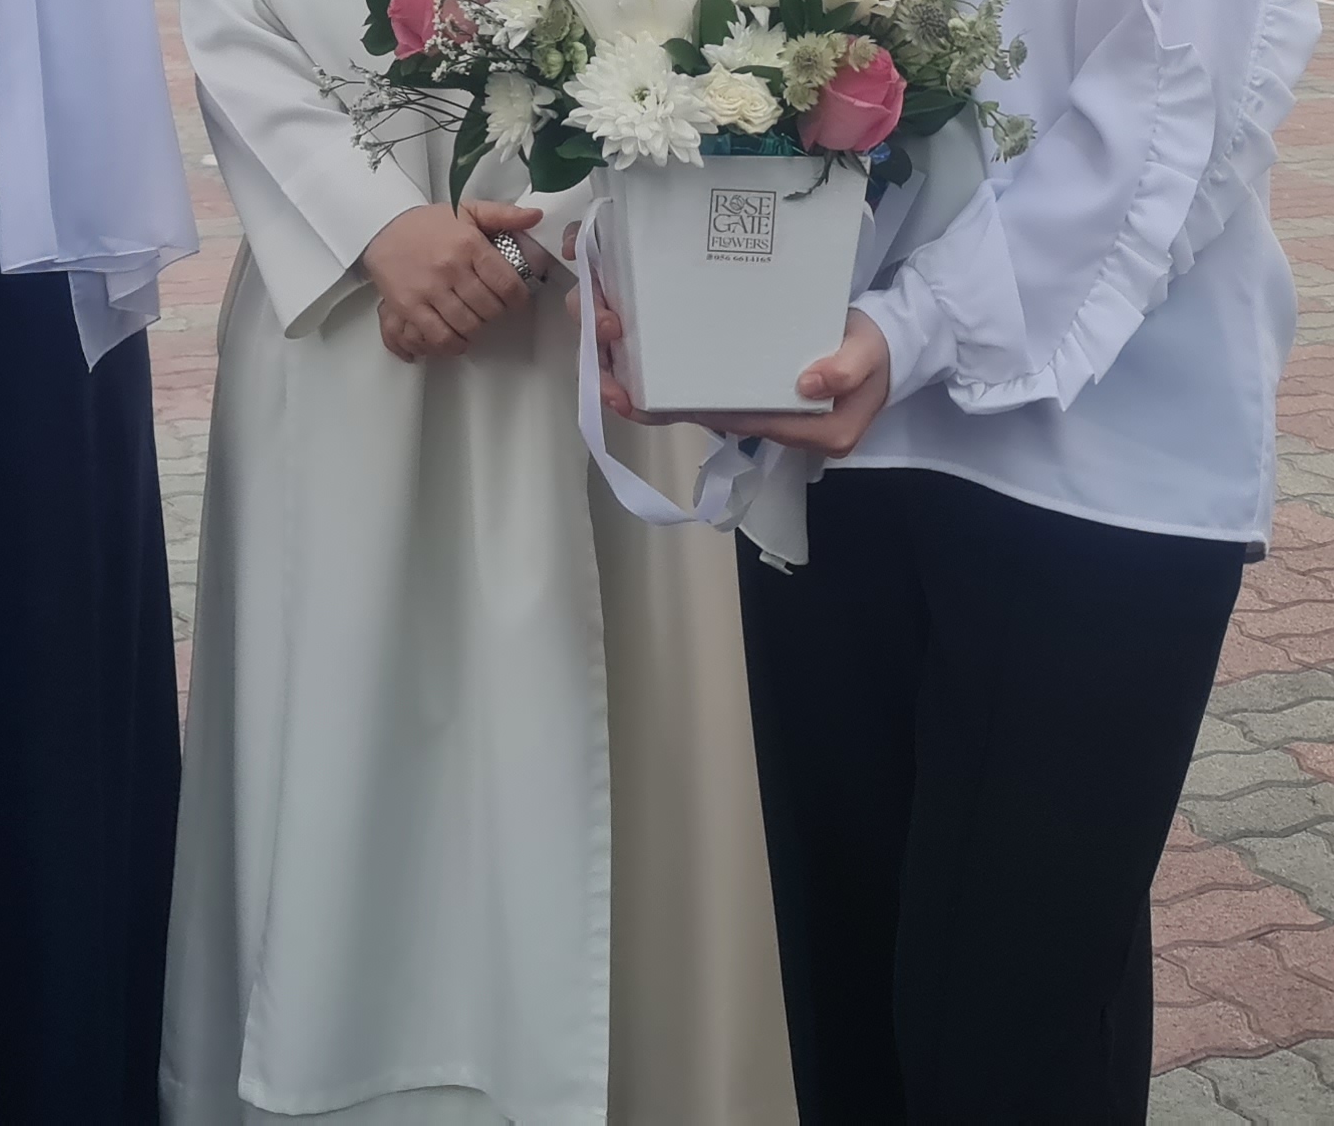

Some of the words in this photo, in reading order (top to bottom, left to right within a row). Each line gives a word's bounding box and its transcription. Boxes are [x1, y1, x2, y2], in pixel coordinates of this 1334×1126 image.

[714, 194, 772, 215] ROSE
[713, 213, 771, 235] GATE
[711, 236, 770, 250] FLOWERS
